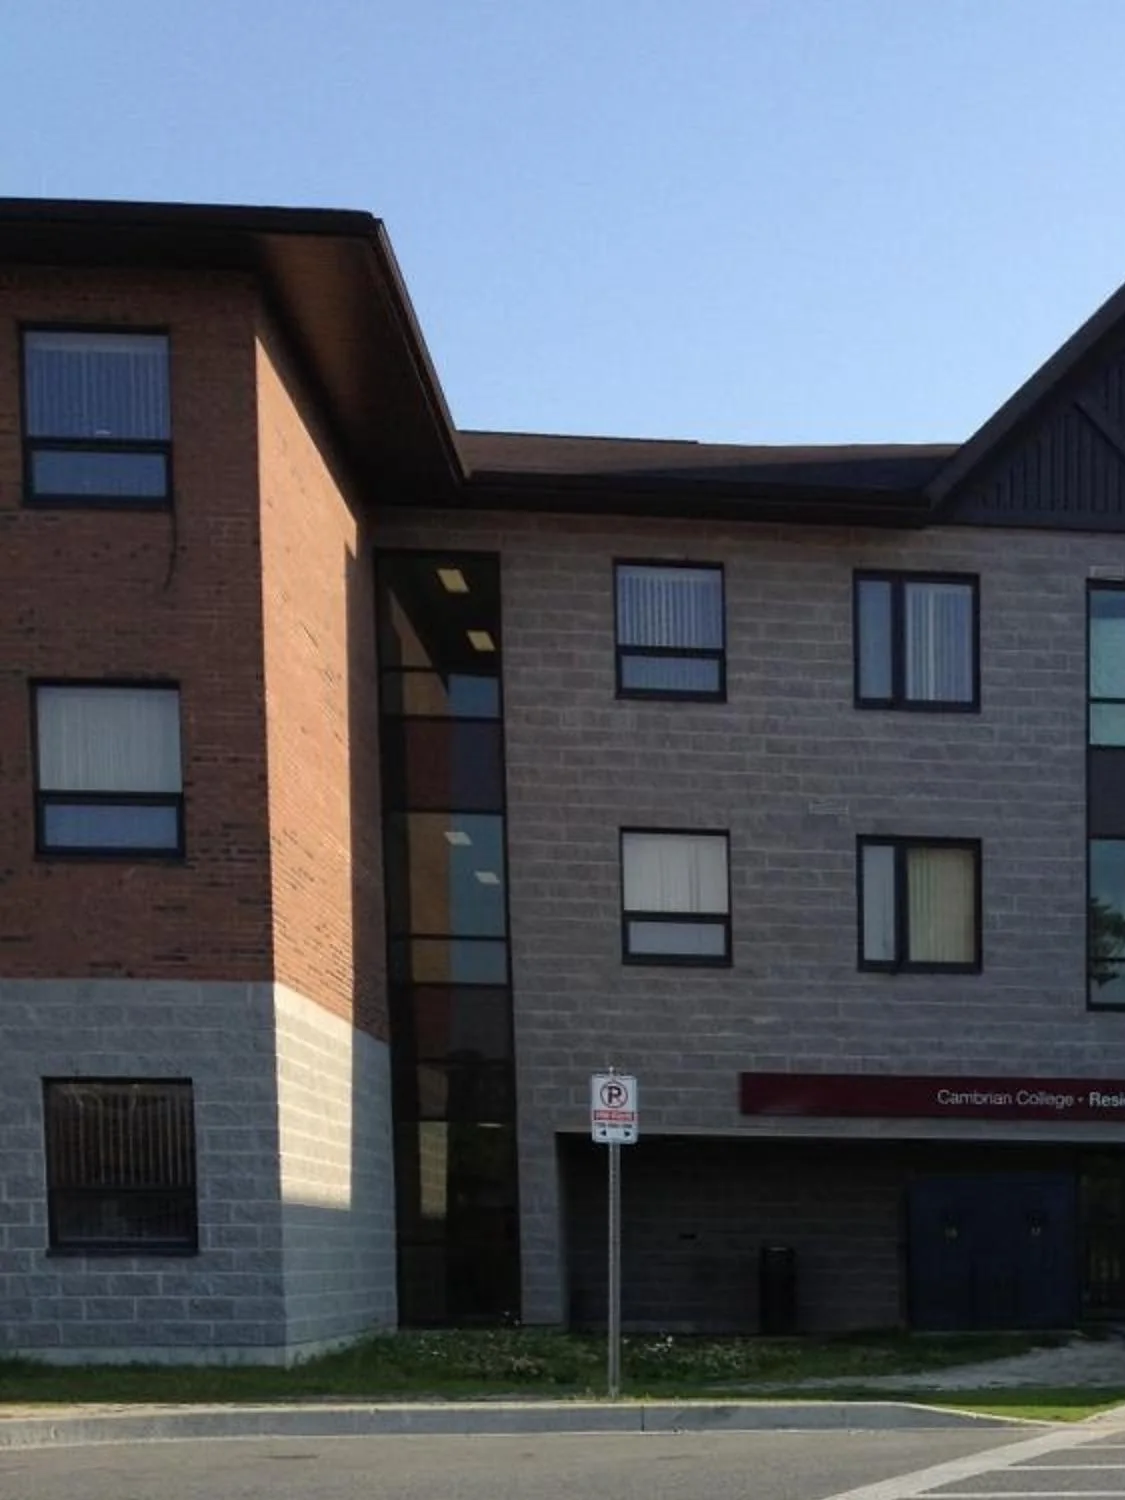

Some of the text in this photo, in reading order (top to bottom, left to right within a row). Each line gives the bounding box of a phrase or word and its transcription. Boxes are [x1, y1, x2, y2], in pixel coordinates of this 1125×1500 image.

[608, 1086, 621, 1103] P
[936, 1089, 1013, 1105] Cambrian
[1016, 1090, 1074, 1109] College
